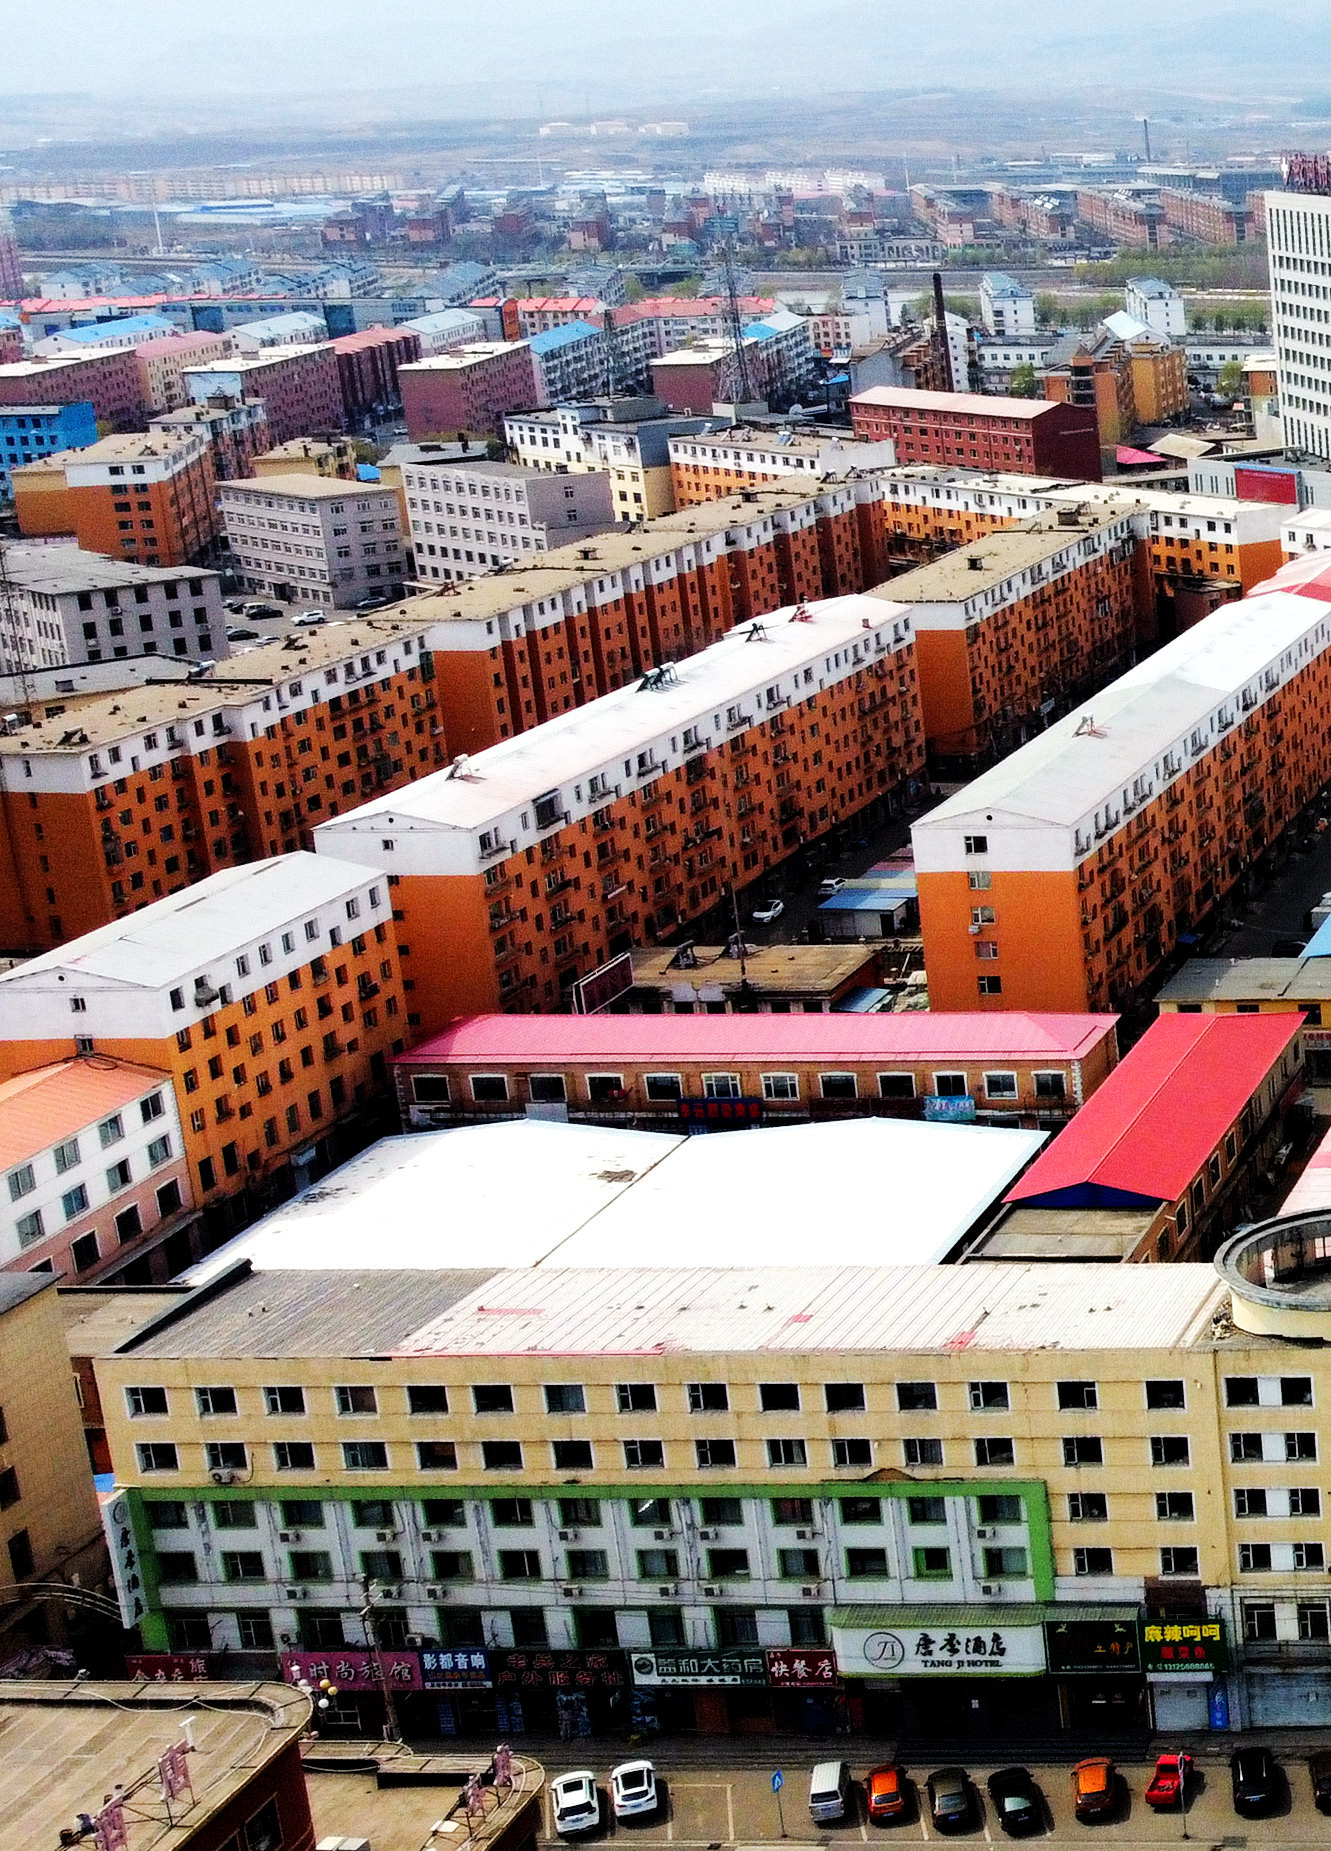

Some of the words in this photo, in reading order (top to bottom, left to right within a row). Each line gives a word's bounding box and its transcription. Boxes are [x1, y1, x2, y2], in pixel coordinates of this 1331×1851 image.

[1144, 1624, 1221, 1642] 麻辣呵呵
[423, 1652, 486, 1670] 影都音响
[770, 1659, 834, 1680] 快餐店
[921, 1660, 953, 1669] TANG
[967, 1660, 1003, 1669] HOTEL
